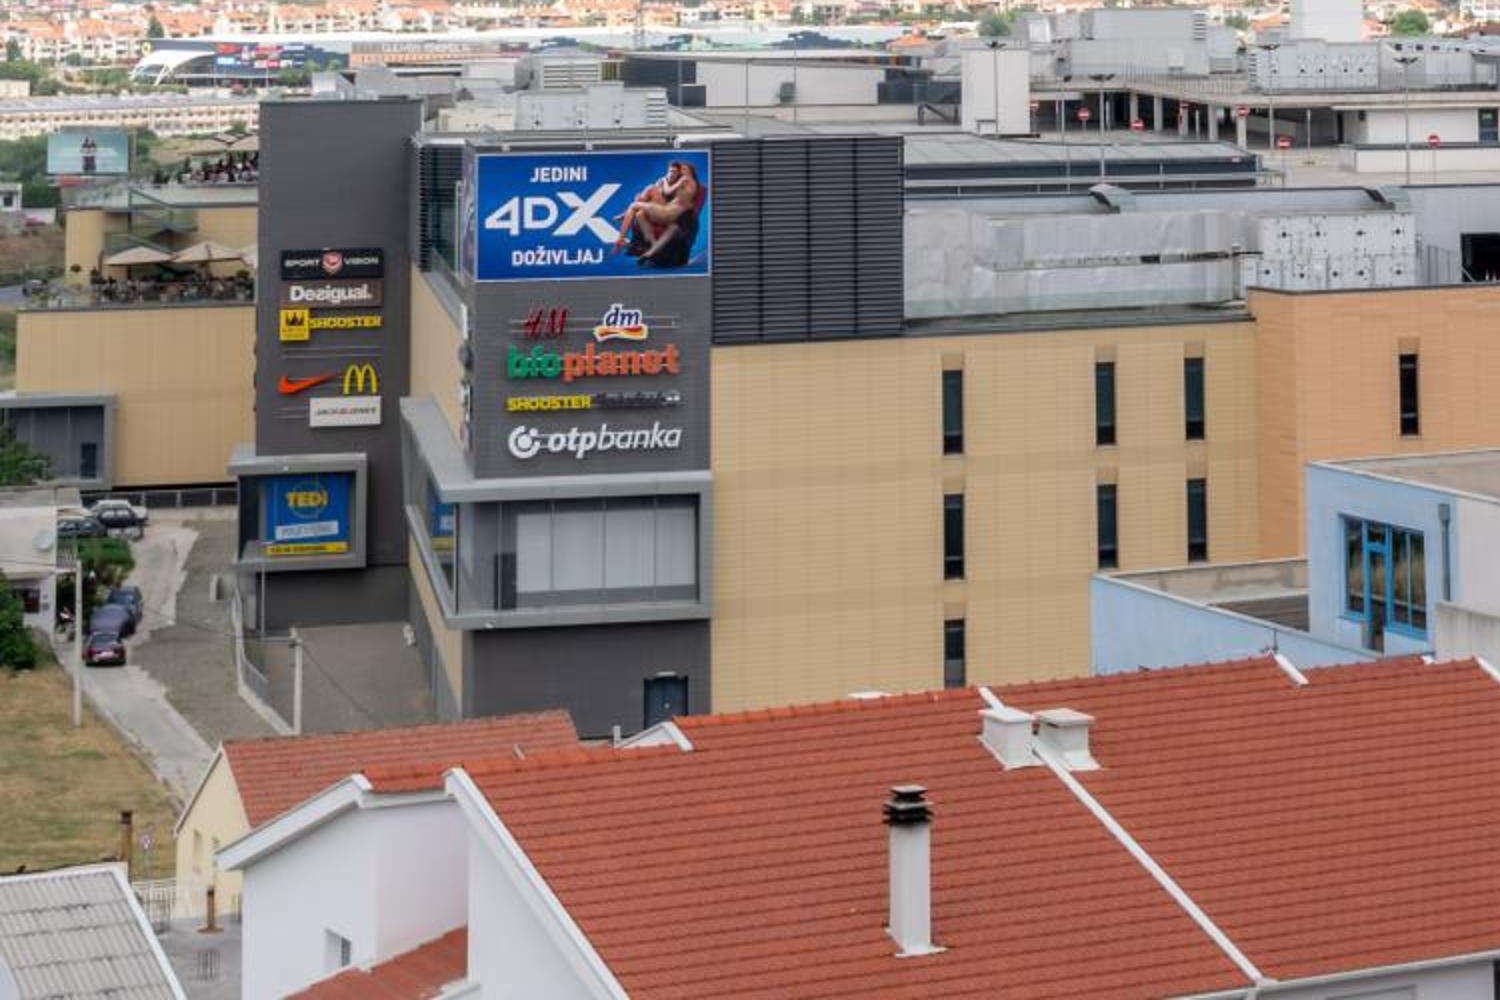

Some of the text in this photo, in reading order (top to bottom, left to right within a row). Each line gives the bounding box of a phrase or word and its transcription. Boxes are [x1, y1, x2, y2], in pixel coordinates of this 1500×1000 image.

[529, 165, 588, 183] JEDINI
[484, 183, 631, 244] 4DX
[511, 245, 604, 267] DOŽIVLJAJ
[604, 303, 642, 329] dm
[507, 394, 593, 412] SHOOSTER
